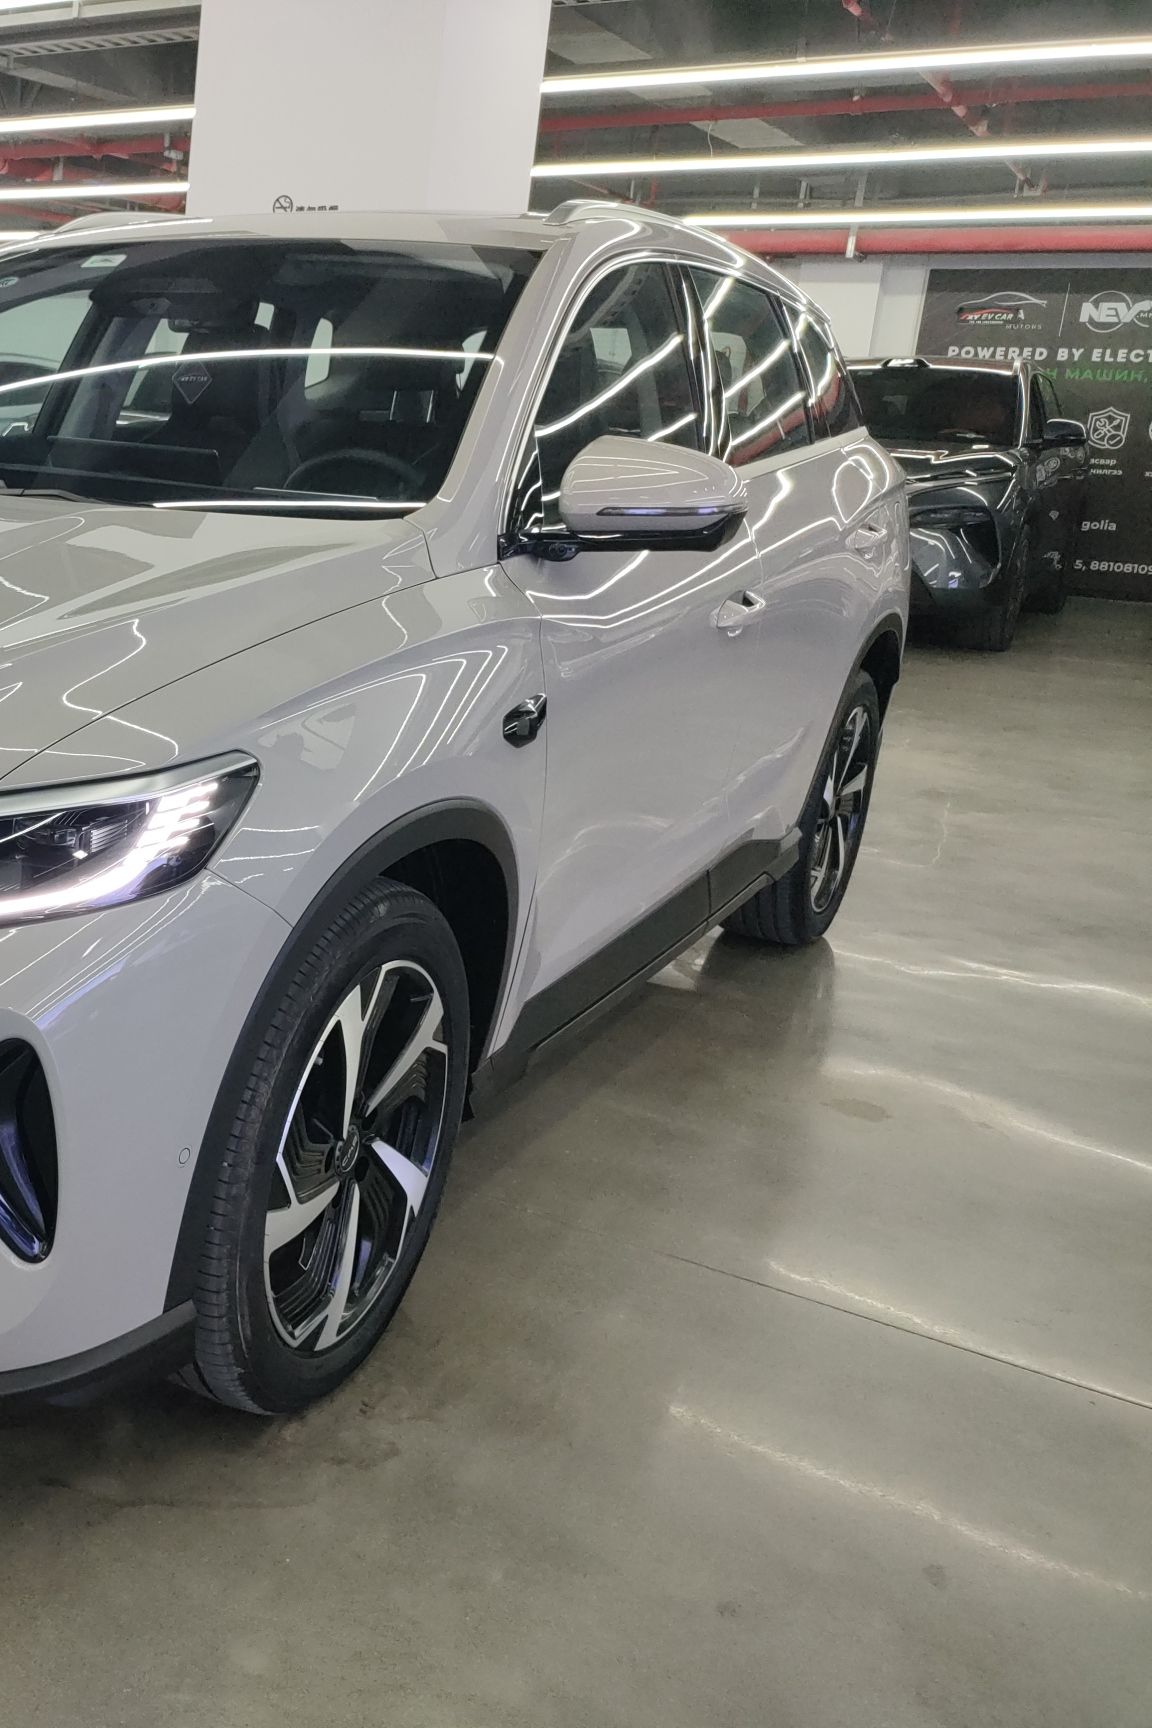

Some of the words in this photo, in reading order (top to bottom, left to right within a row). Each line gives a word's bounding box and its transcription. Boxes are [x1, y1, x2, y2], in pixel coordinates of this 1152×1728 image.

[947, 345, 1048, 361] POWERED
[1056, 347, 1084, 361] BY
[1081, 520, 1117, 531] golia
